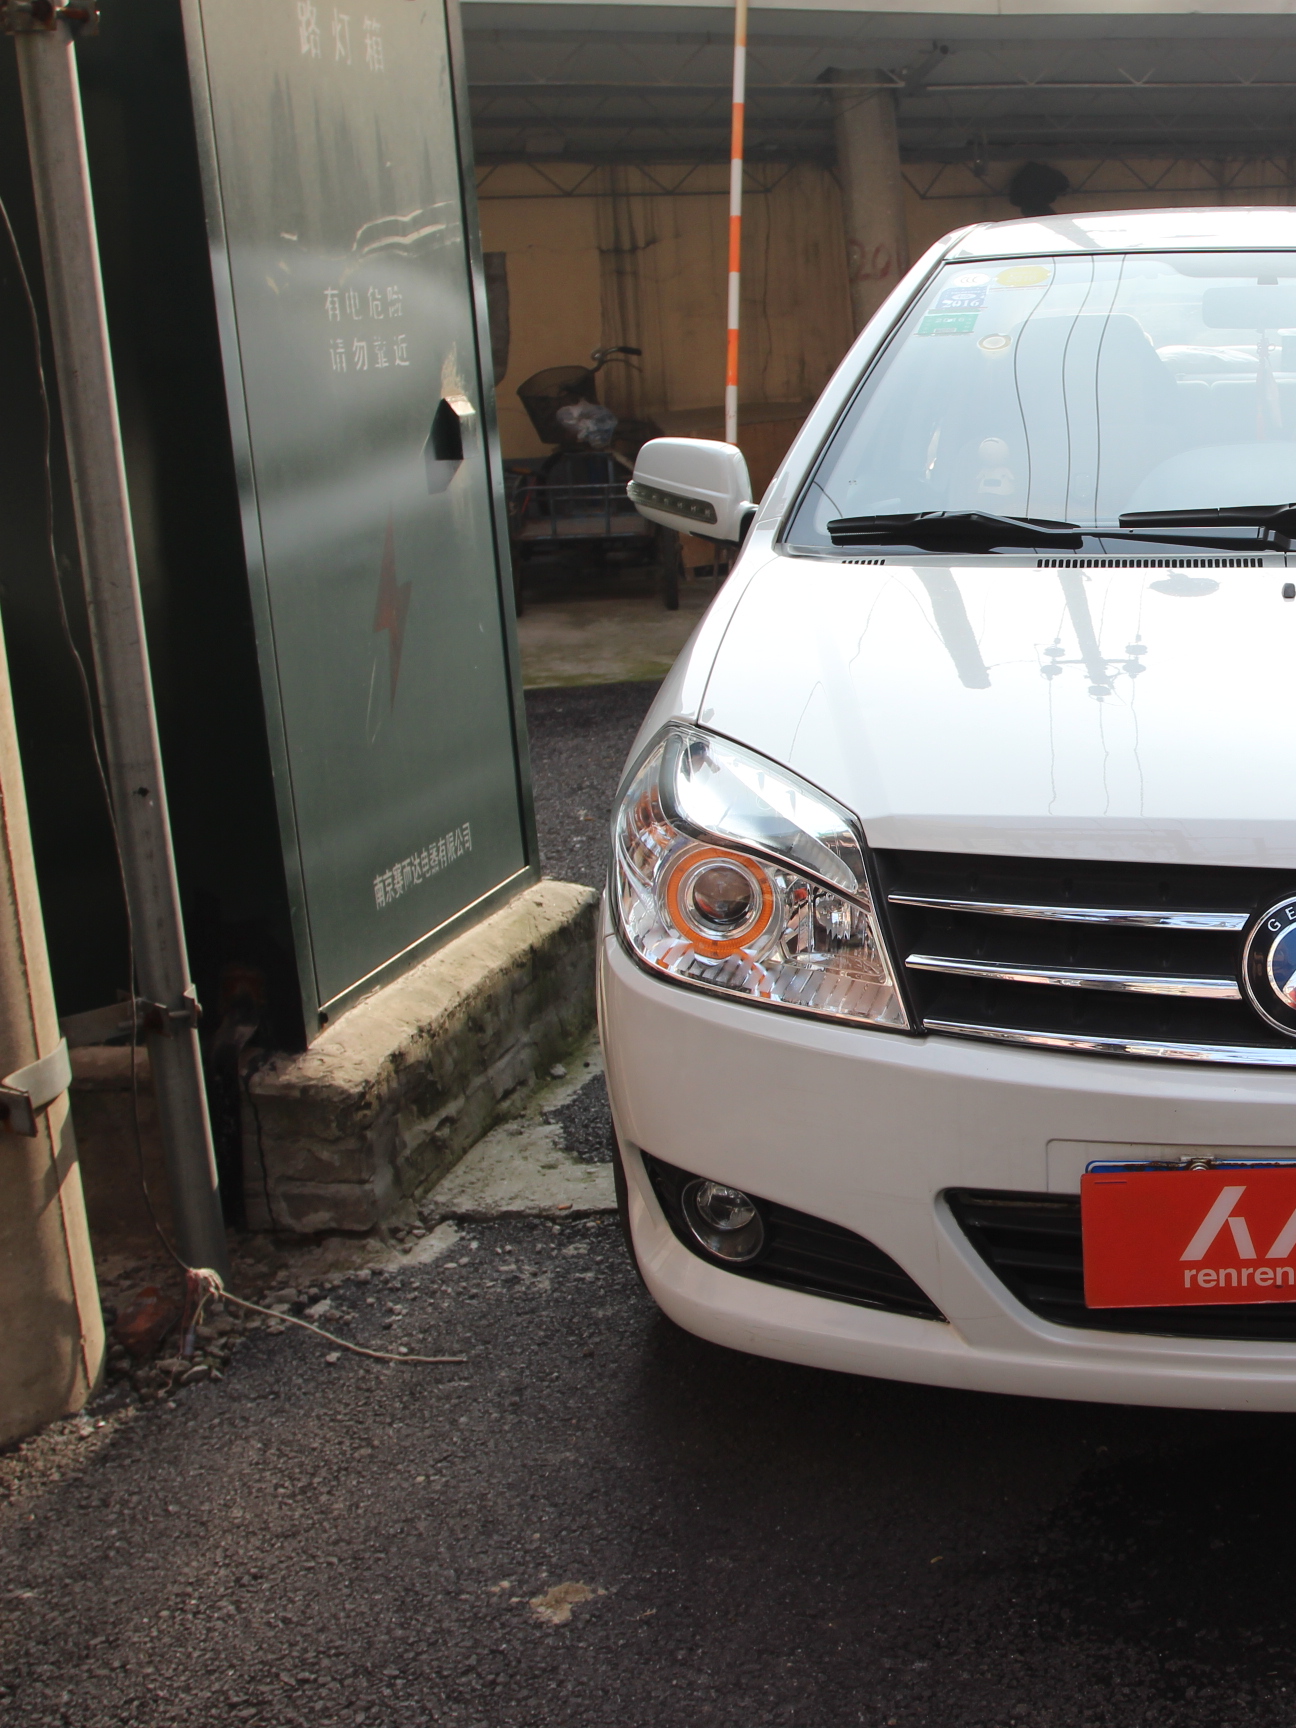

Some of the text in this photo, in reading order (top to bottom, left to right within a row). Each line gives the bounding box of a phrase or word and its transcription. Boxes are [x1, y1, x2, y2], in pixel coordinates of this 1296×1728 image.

[297, 0, 384, 72] 路灯箱
[323, 285, 403, 321] 有电危险
[941, 299, 981, 308] 2016
[329, 334, 410, 373] 请勿靠近
